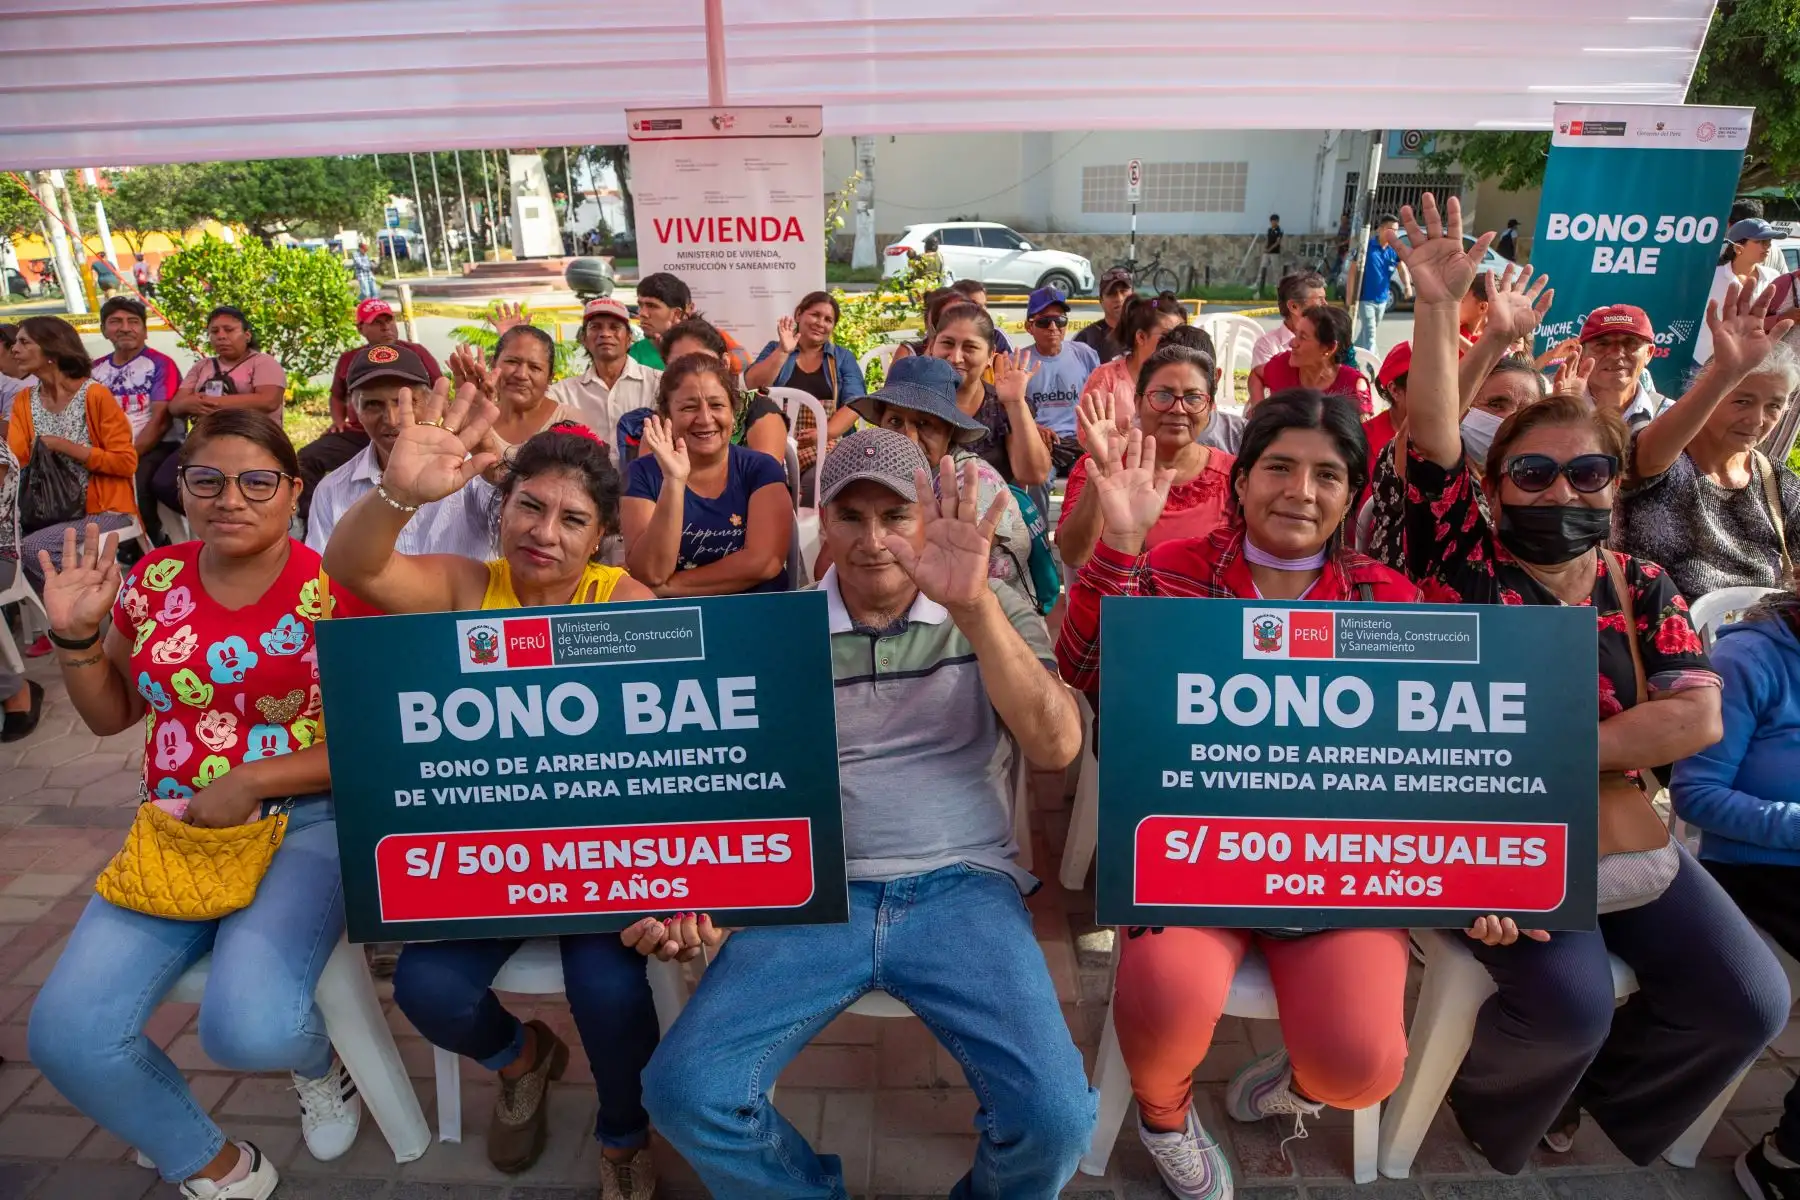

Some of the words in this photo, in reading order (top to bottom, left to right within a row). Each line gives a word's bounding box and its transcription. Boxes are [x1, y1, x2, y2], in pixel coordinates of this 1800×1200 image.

[653, 216, 805, 244] VIVIENDA
[1545, 213, 1648, 242] BONO
[1653, 215, 1719, 244] 500
[663, 261, 727, 271] CONSTRUCCIÓN
[736, 262, 796, 270] SANEAMIENTO
[677, 250, 725, 259] MINISTERIO
[727, 250, 737, 258] DE
[739, 250, 781, 258] VIVIENDA,
[1591, 246, 1661, 274] BAE
[1032, 390, 1079, 402] Reebok
[557, 621, 610, 633] Ministerio
[1294, 626, 1329, 641] PERÚ
[1340, 618, 1392, 629] Ministerio
[510, 632, 546, 650] PERÚ
[558, 634, 571, 645] de
[573, 631, 622, 645] Vivienda,
[624, 628, 693, 641] Construcción
[1340, 629, 1354, 640] de
[1356, 630, 1402, 642] Vivienda,
[1404, 631, 1470, 643] Construcción
[1340, 643, 1346, 652] y
[1348, 641, 1415, 653] Saneamiento
[559, 648, 565, 658] y
[567, 643, 637, 656] Saneamiento
[398, 681, 599, 743] BONO
[621, 676, 760, 735] BAE
[1177, 673, 1374, 728] BONO
[1397, 680, 1527, 733] BAE
[419, 758, 489, 779] BONO
[497, 757, 528, 776] DE
[535, 745, 747, 774] ARRENDAMIENTO
[1191, 743, 1261, 763] BONO
[1268, 745, 1300, 763] DE
[1306, 745, 1512, 767] ARRENDAMIENTO
[395, 789, 427, 807] DE
[432, 783, 548, 806] VIVIENDA
[554, 779, 621, 800] PARA
[627, 771, 786, 796] EMERGENCIA
[1162, 770, 1194, 788] DE
[1200, 770, 1316, 790] VIVIENDA
[1323, 772, 1388, 791] PARA
[1394, 774, 1547, 794] EMERGENCIA
[405, 842, 446, 879] S/
[457, 843, 530, 874] 500
[543, 833, 792, 871] MENSUALES
[1165, 826, 1209, 864] S/
[1217, 831, 1292, 862] 500
[1304, 833, 1547, 867] MENSUALES
[508, 882, 568, 905] POR
[583, 881, 600, 901] 2
[607, 874, 690, 900] AÑOS
[1265, 873, 1325, 896] POR
[1340, 875, 1356, 896] 2
[1364, 869, 1443, 897] AÑOS
